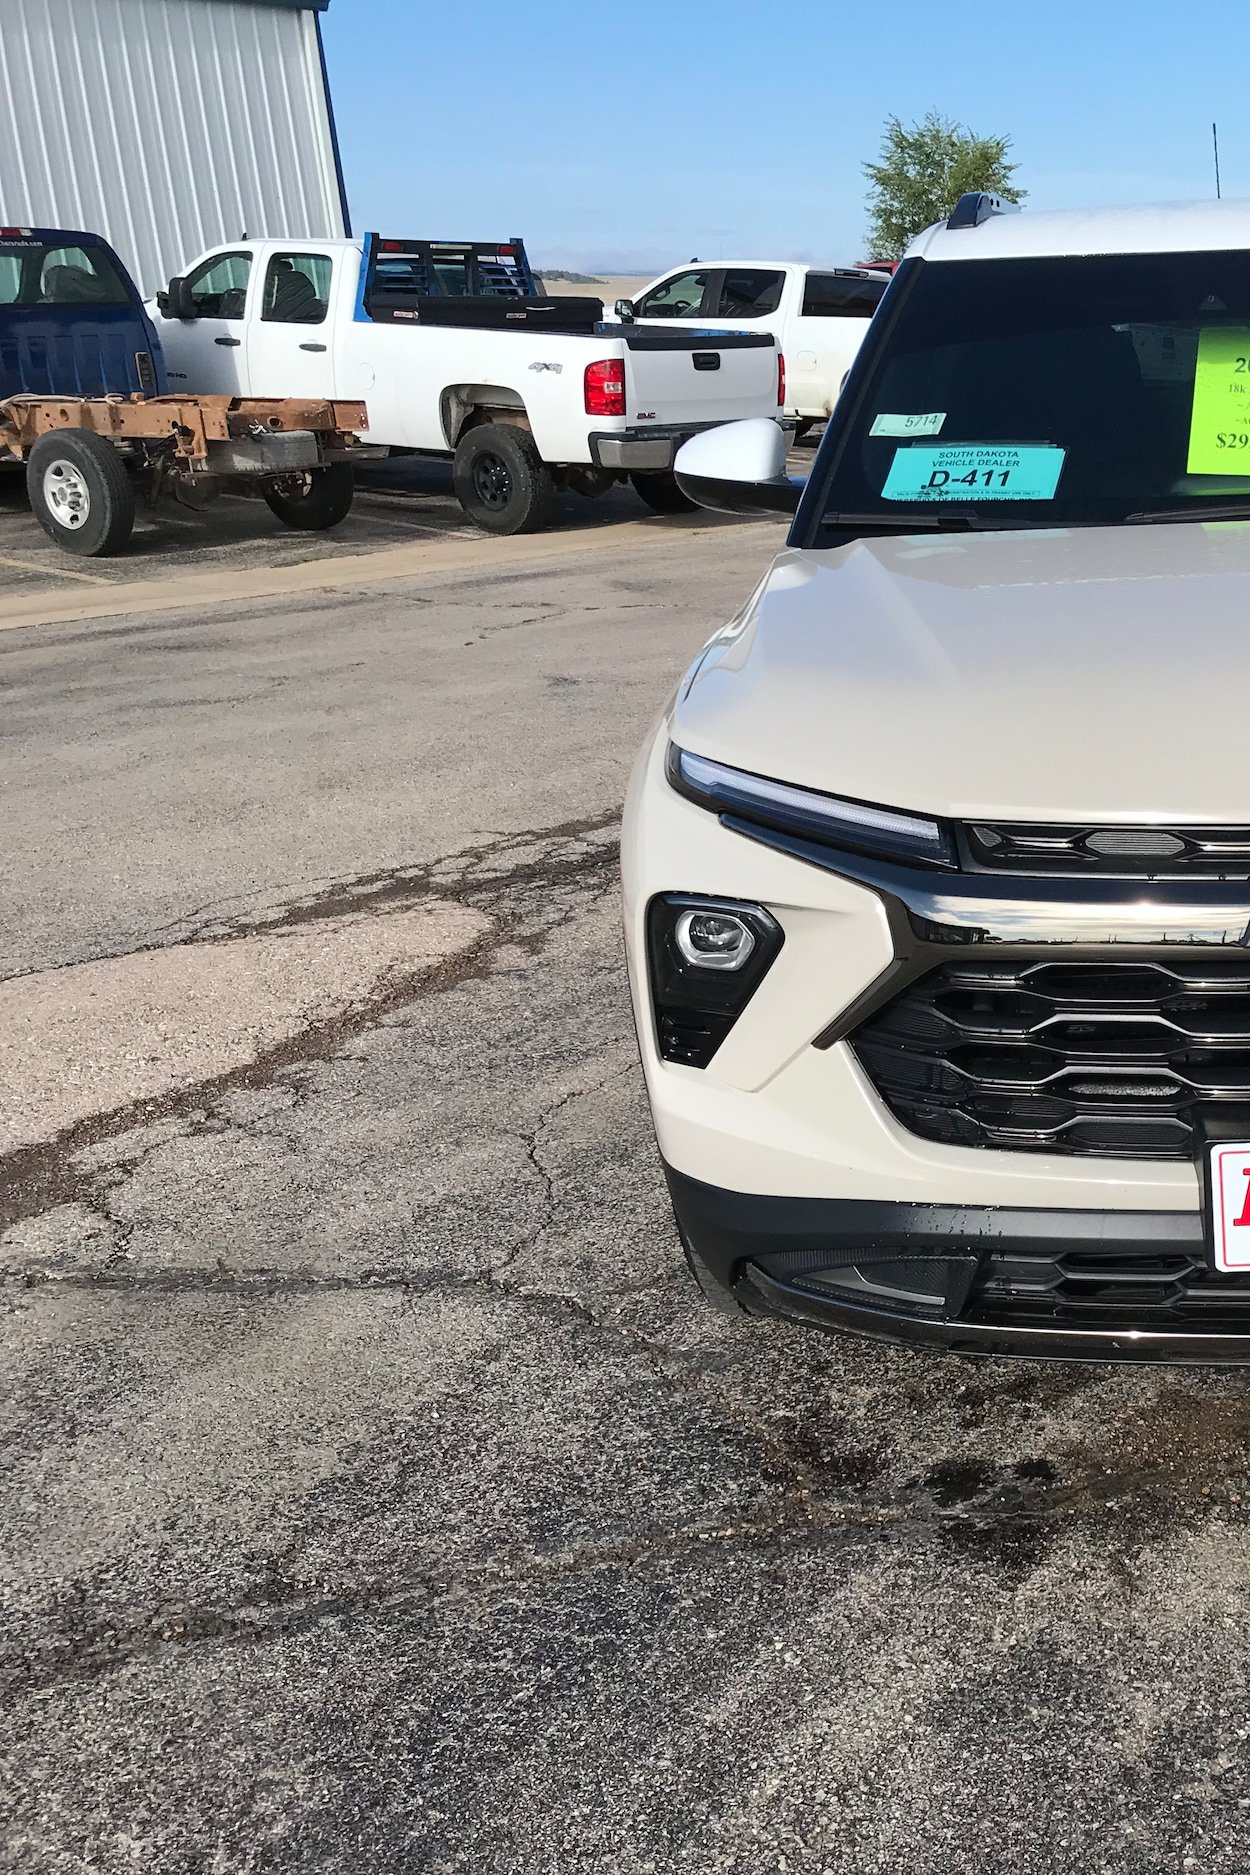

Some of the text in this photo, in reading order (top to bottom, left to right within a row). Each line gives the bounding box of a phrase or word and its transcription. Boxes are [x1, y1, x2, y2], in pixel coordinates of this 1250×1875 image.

[1228, 383, 1246, 394] 18k
[905, 415, 938, 428] 5714
[938, 450, 1019, 459] SOUTH DAKOTA
[932, 459, 1020, 468] VEHICLE DEALER
[927, 469, 1011, 488] D-411
